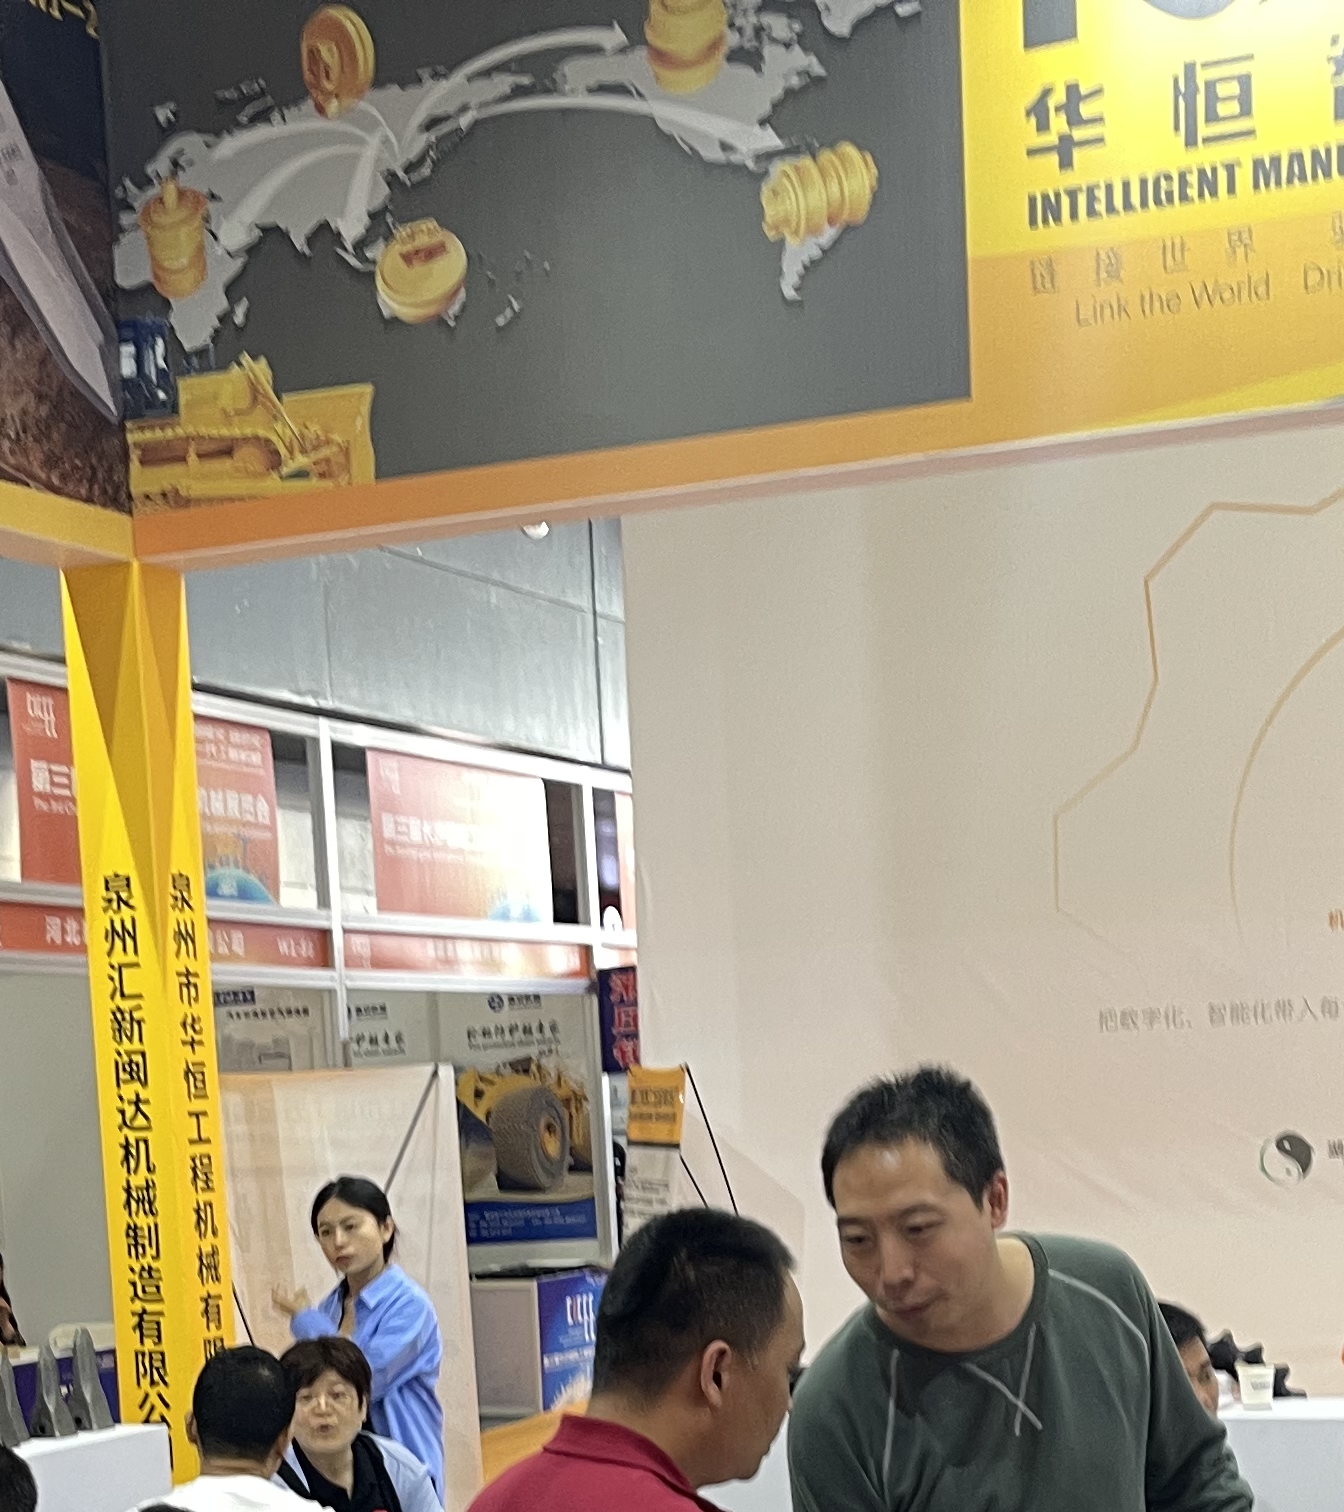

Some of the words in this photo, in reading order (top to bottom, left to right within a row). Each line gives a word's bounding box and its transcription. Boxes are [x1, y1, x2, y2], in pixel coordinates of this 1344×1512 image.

[1028, 162, 1242, 230] INTELLIGENT
[1073, 290, 1131, 328] Link
[1139, 285, 1183, 318] the
[1190, 271, 1273, 312] World
